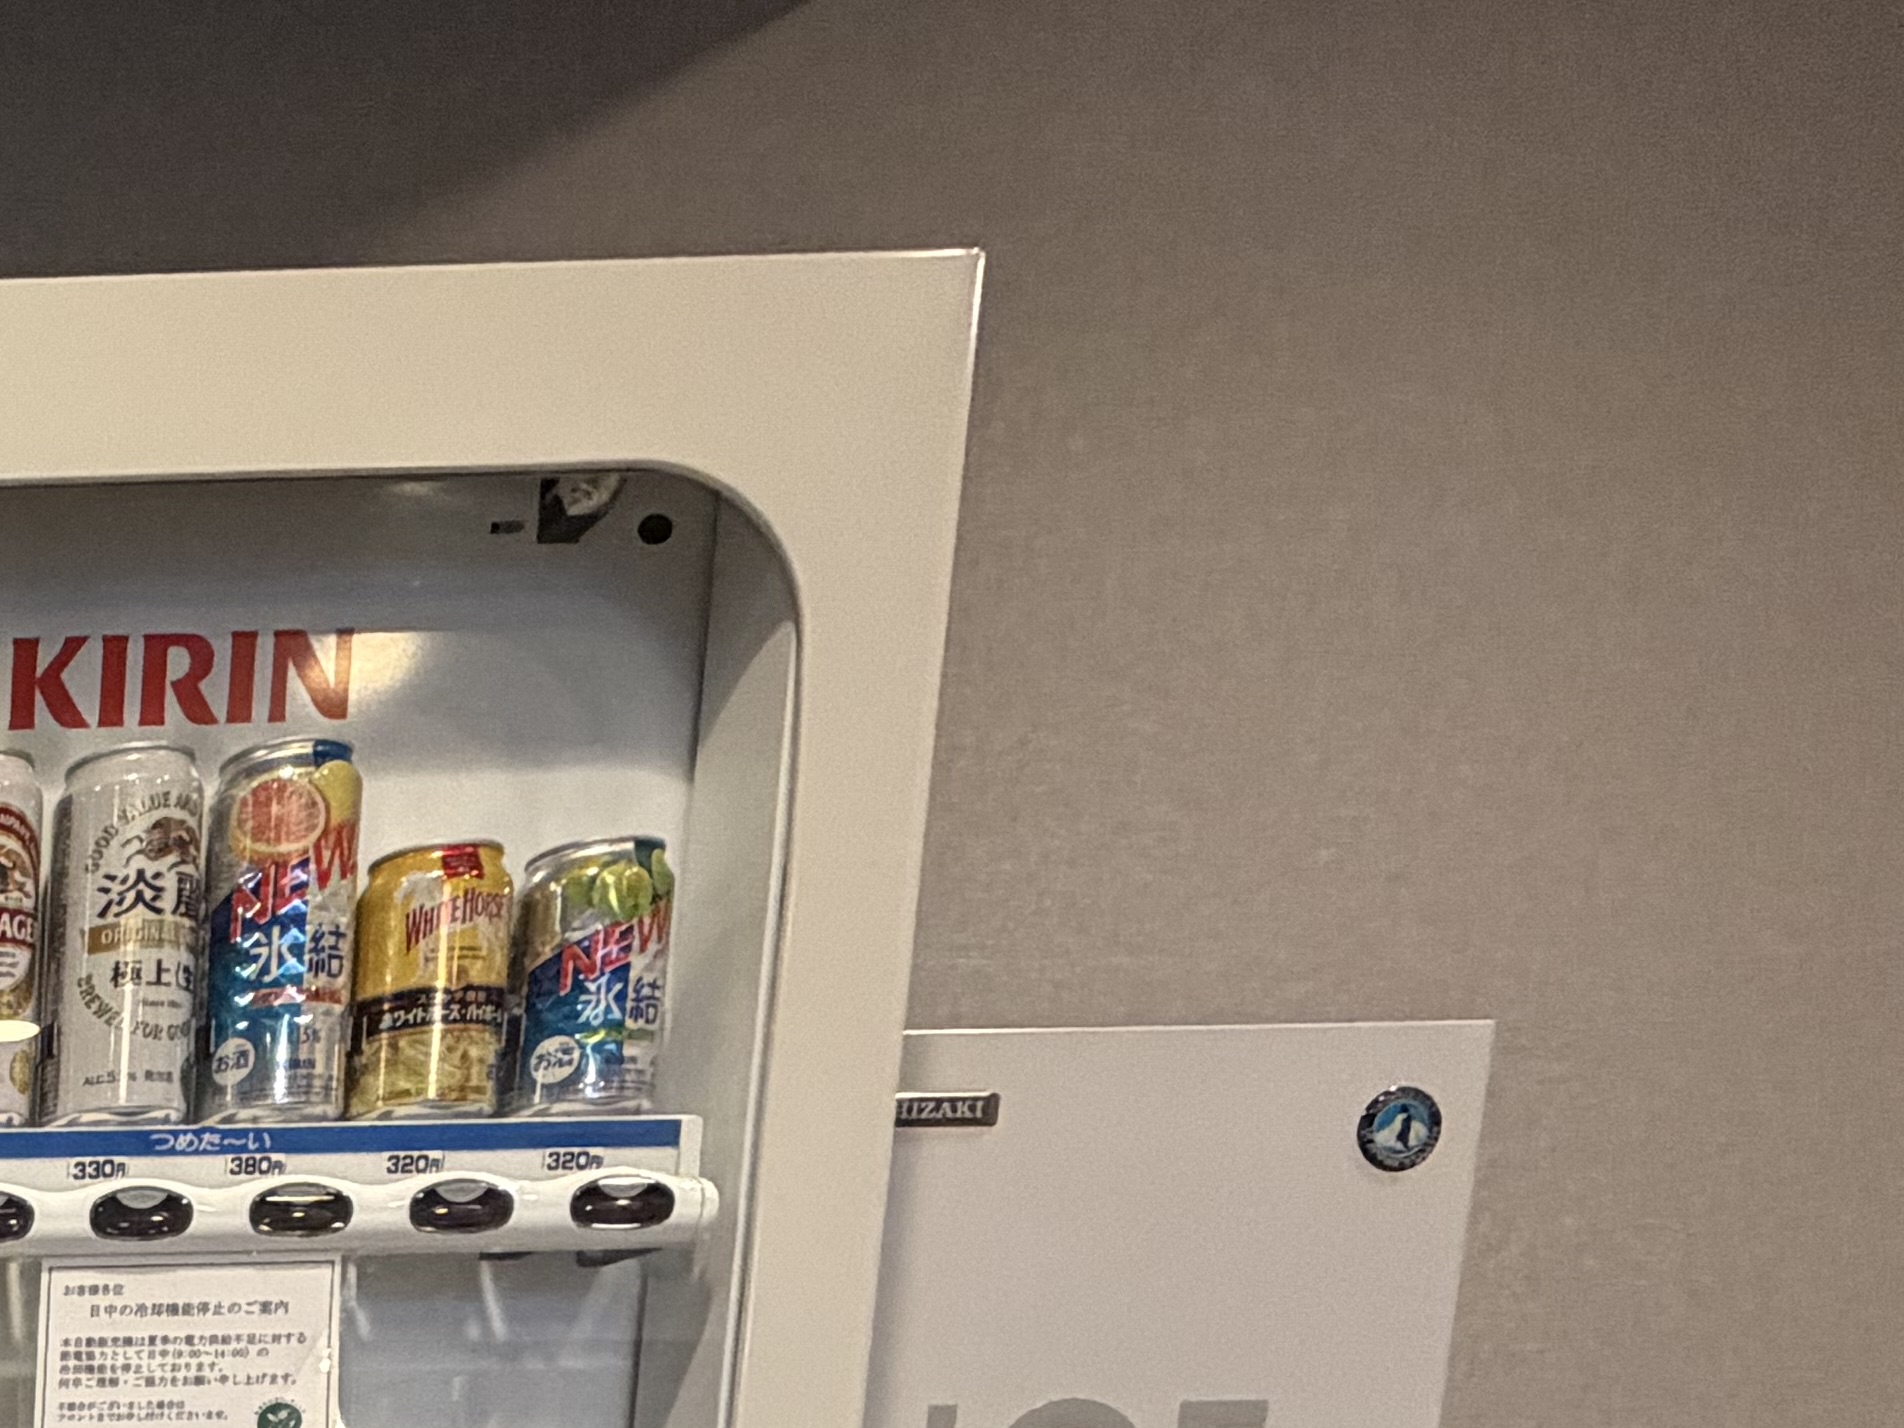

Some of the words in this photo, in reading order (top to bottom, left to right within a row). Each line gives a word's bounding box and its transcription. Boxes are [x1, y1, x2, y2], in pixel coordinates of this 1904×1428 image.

[9, 630, 354, 731] KIRIN
[73, 1159, 126, 1180] 330円
[229, 1156, 285, 1177] 380円
[386, 1154, 441, 1174] 320円
[546, 1151, 604, 1172] 320円
